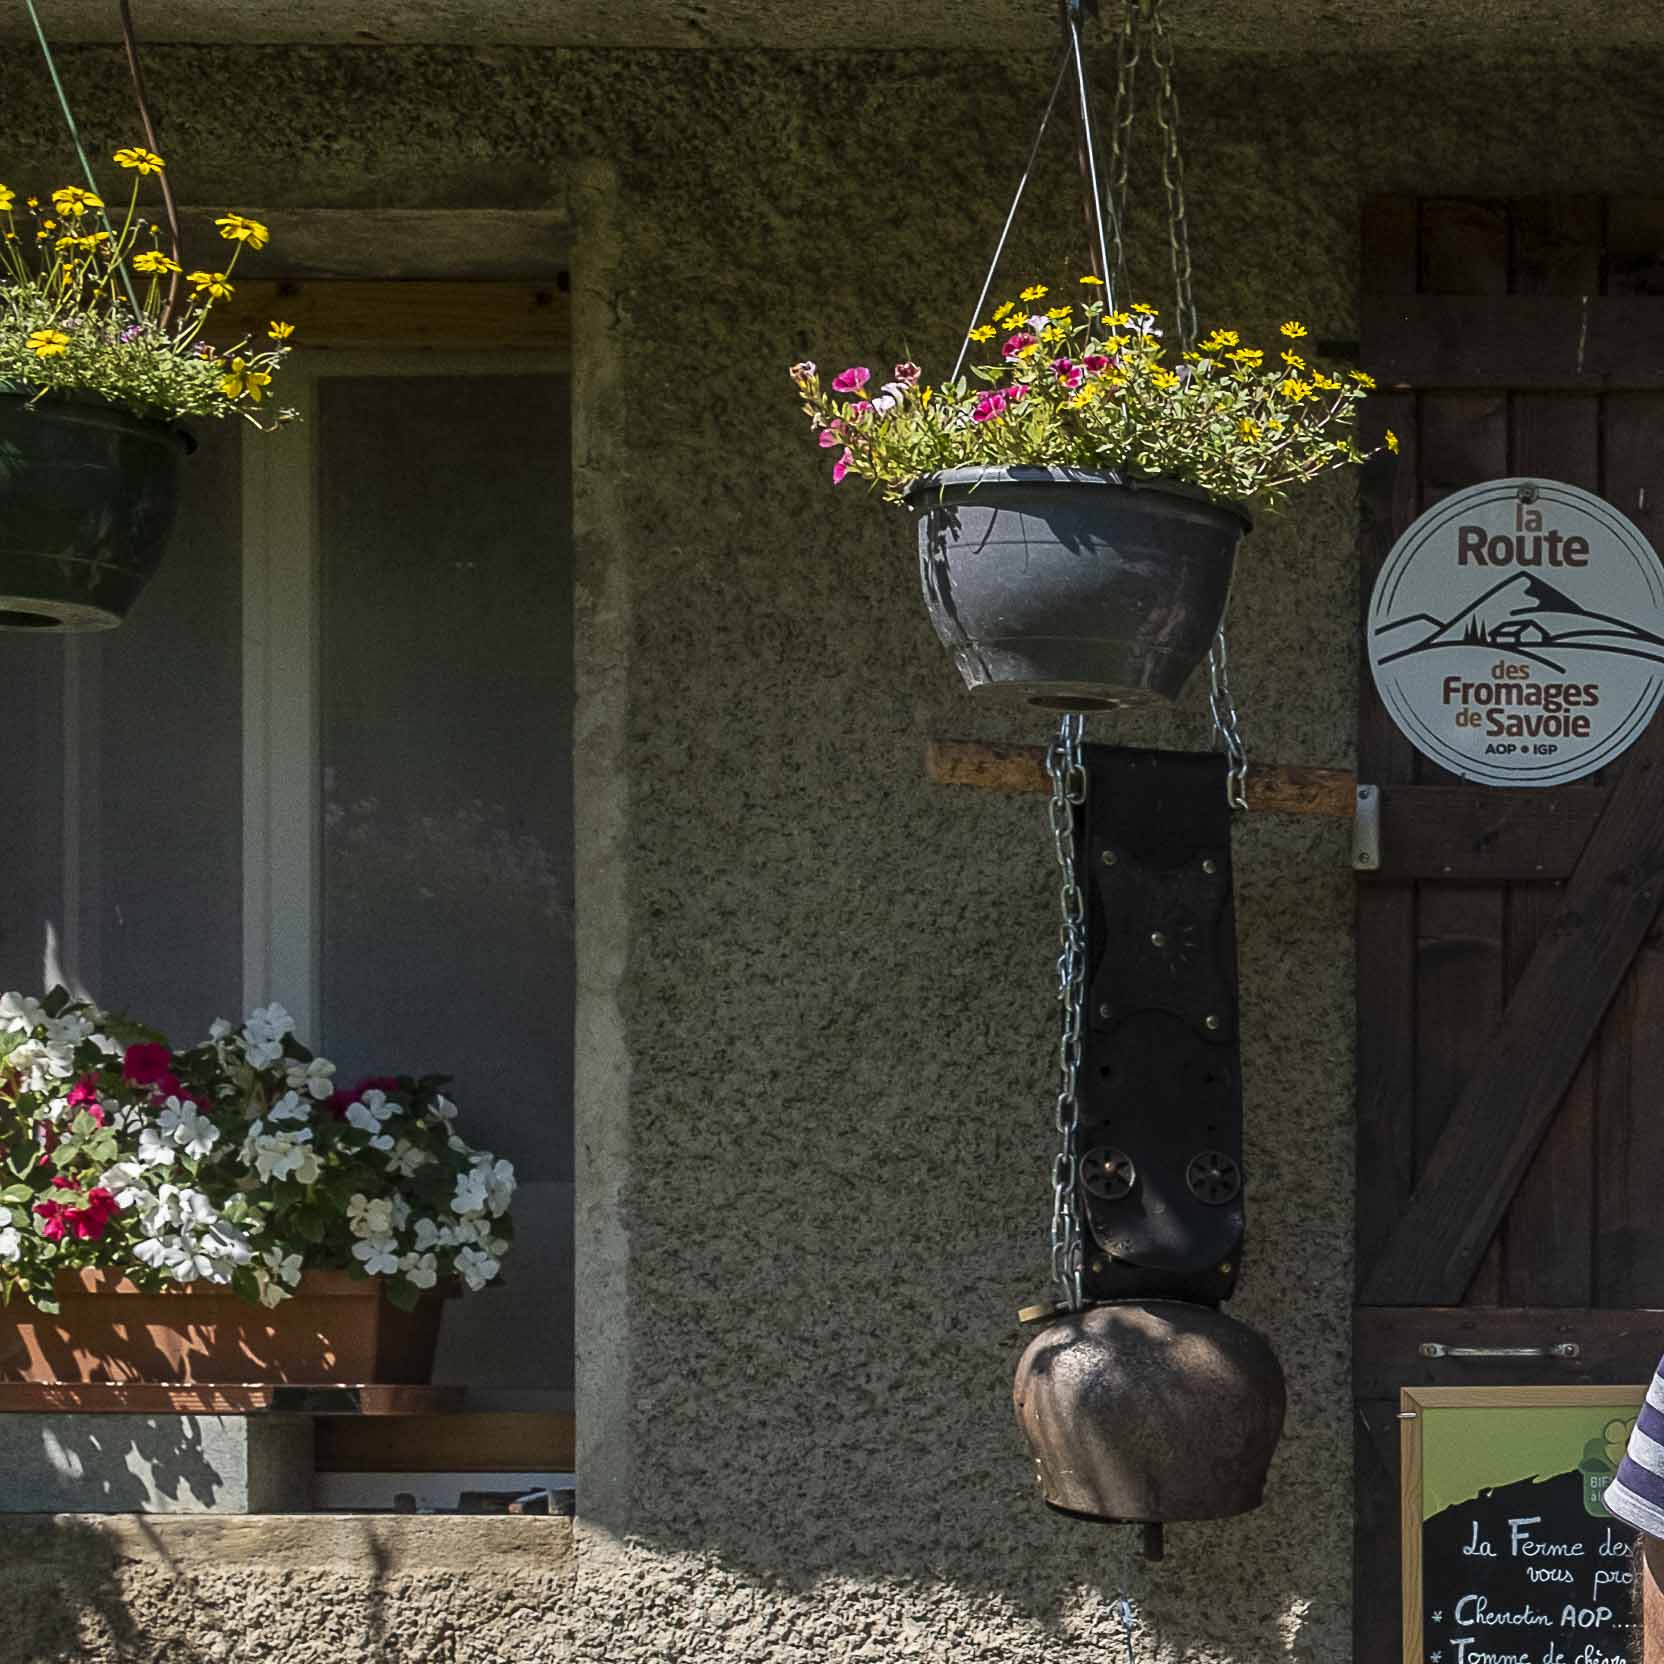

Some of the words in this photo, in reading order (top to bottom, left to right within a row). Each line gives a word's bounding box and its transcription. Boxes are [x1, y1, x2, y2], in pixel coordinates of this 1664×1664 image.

[1515, 503, 1543, 532] la
[1457, 526, 1590, 567] Route
[1491, 660, 1530, 680] des
[1443, 676, 1599, 713] Fromages
[1456, 708, 1482, 727] de
[1486, 708, 1591, 737] Savoie
[1485, 744, 1517, 755] AOP
[1533, 744, 1558, 755] IGP
[1462, 1521, 1496, 1557] La
[1508, 1516, 1585, 1557] Ferme
[1599, 1527, 1633, 1557] des
[1526, 1566, 1575, 1584] vous
[1455, 1594, 1553, 1627] Chevrotin
[1450, 1637, 1531, 1664] Tomme
